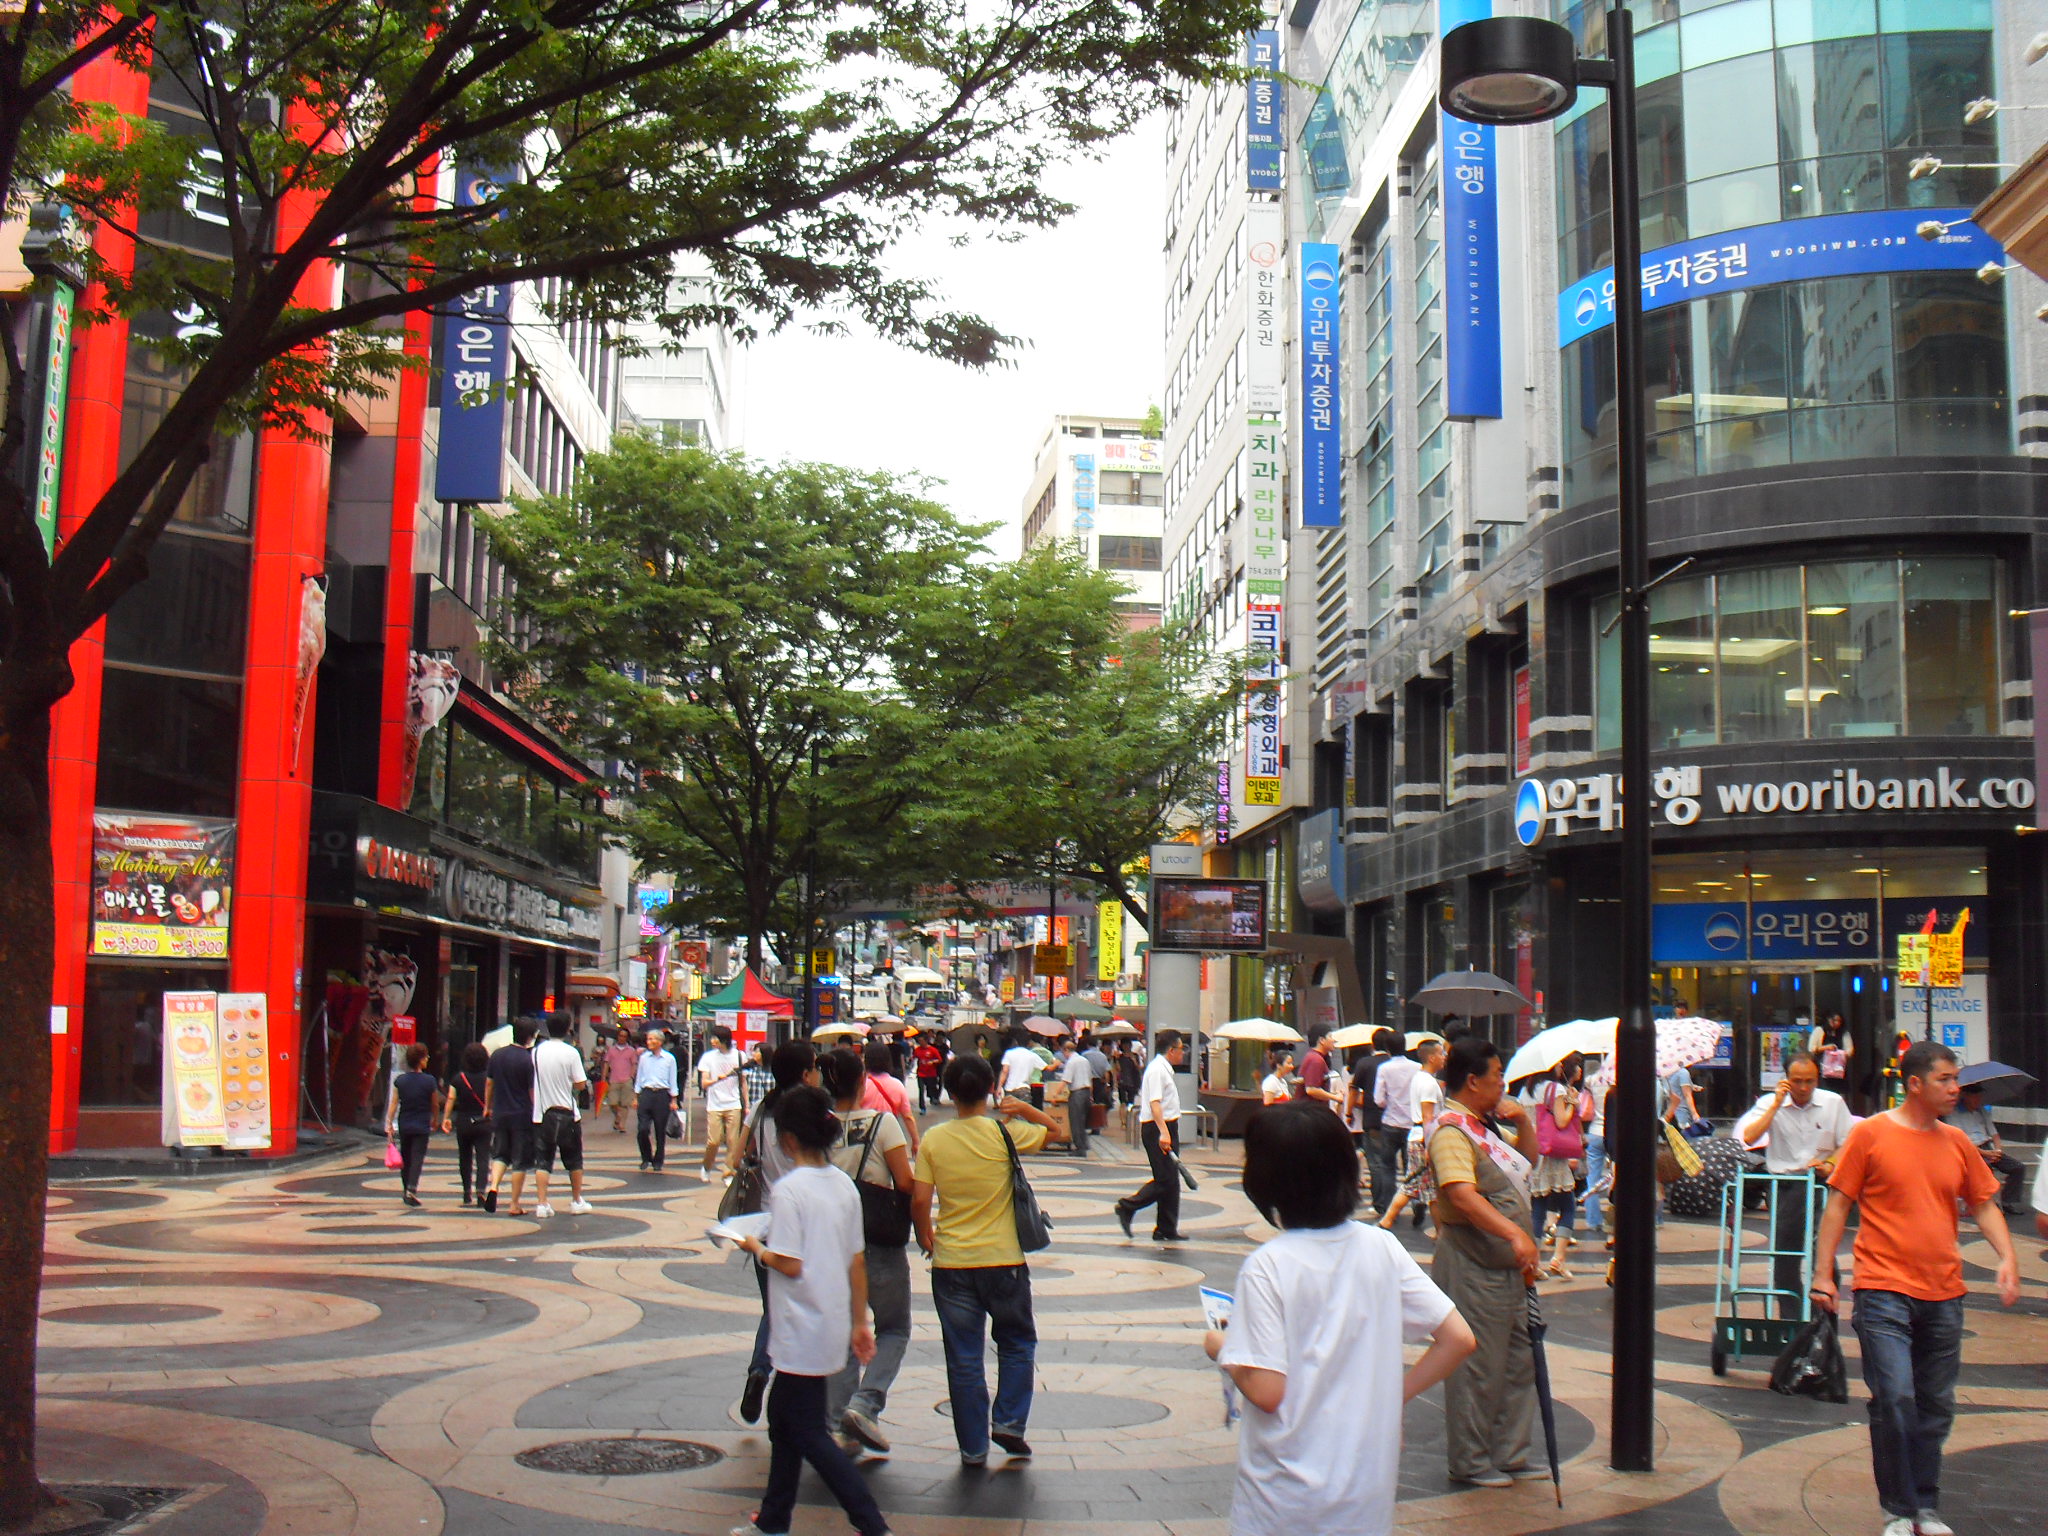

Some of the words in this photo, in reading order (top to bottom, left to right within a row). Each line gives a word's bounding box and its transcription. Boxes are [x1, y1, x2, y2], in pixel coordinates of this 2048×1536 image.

[1251, 169, 1278, 177] KYOBO
[1454, 118, 1485, 194] 은행
[1771, 236, 1907, 258] WOORIWM.COM
[1469, 219, 1480, 327] WOORIBANK
[1600, 243, 1749, 312] 우투자증권
[1257, 271, 1274, 347] 한화증권
[1309, 297, 1333, 431] 우리투자증권
[1252, 434, 1279, 481] 치과
[1253, 489, 1276, 560] 라임나무
[1247, 780, 1280, 792] 이비인
[1253, 791, 1275, 803] 후과
[1546, 766, 1702, 836] 우리행
[1717, 767, 2036, 814] wooribank.co
[99, 850, 179, 883] Matching
[104, 884, 172, 918] 매칭몰
[1753, 911, 1870, 948] 우리은행
[1902, 1000, 1982, 1013] EXCHANGE
[1915, 986, 1966, 999] MONEY
